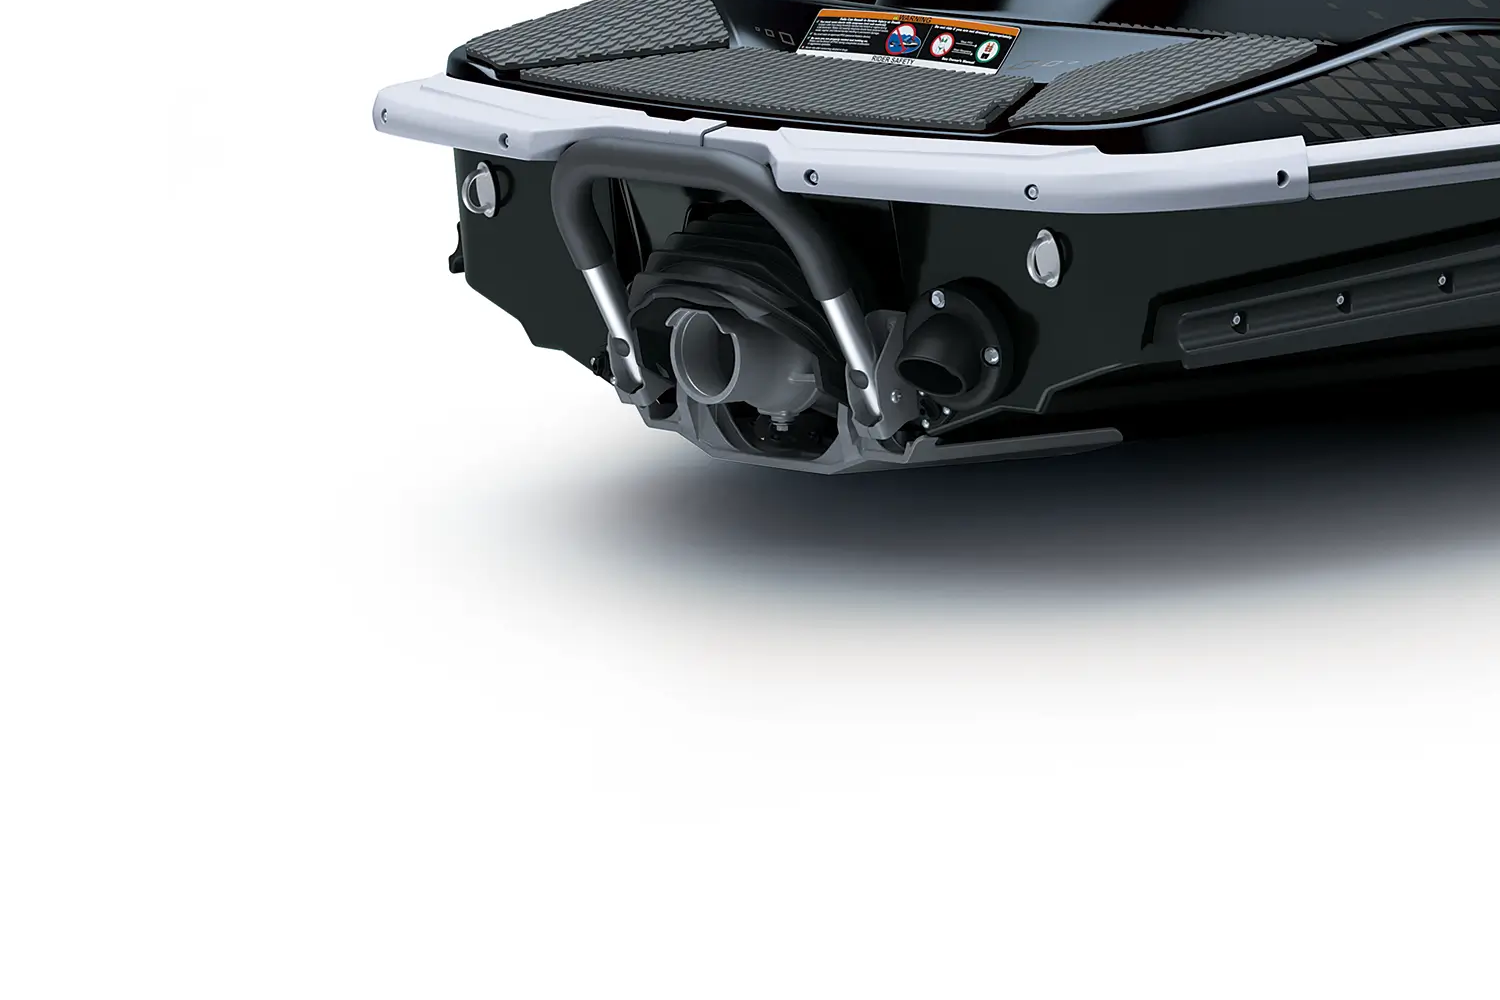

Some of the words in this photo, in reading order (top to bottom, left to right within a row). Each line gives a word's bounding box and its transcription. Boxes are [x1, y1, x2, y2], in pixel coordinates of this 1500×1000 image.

[899, 14, 932, 23] WARNING
[871, 55, 890, 63] RIDER
[891, 57, 915, 65] SAFETY
